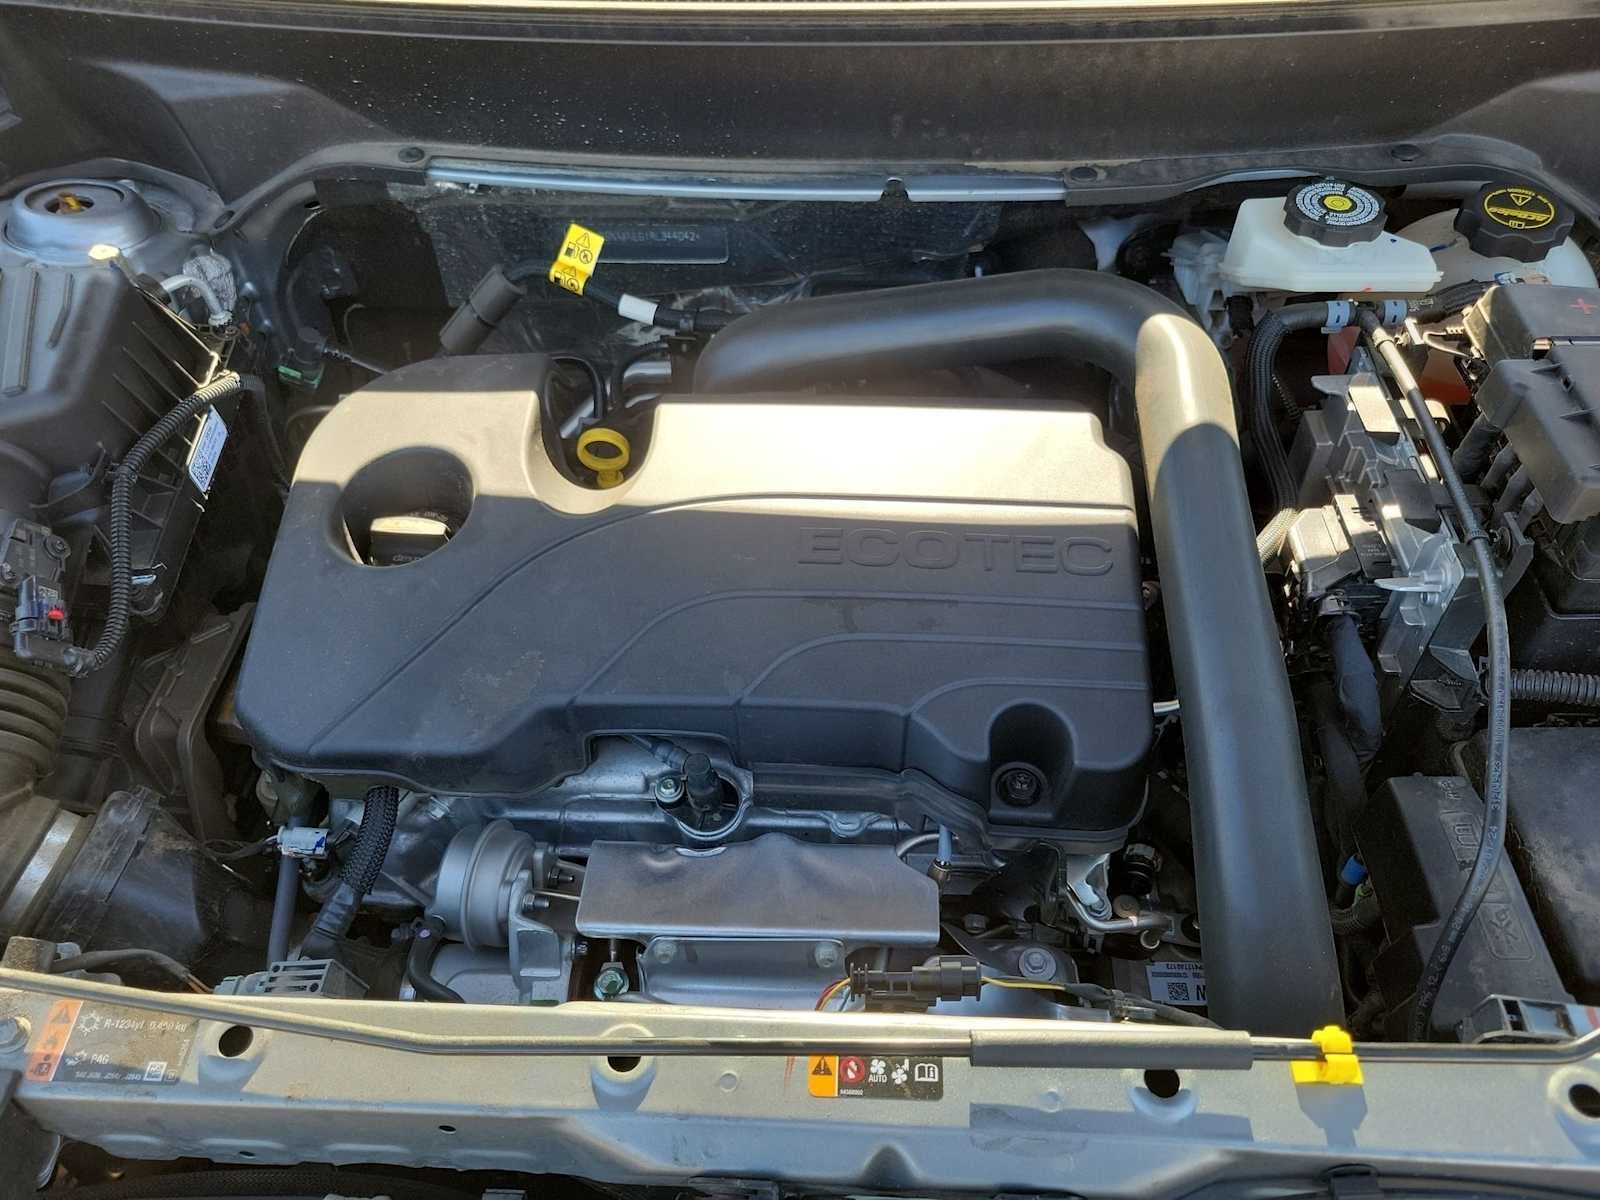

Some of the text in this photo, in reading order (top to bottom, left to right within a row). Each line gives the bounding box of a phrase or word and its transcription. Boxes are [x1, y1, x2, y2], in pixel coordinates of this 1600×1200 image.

[798, 526, 1114, 577] ECOTEC
[90, 1054, 110, 1065] PAG
[868, 1074, 888, 1083] AUTO
